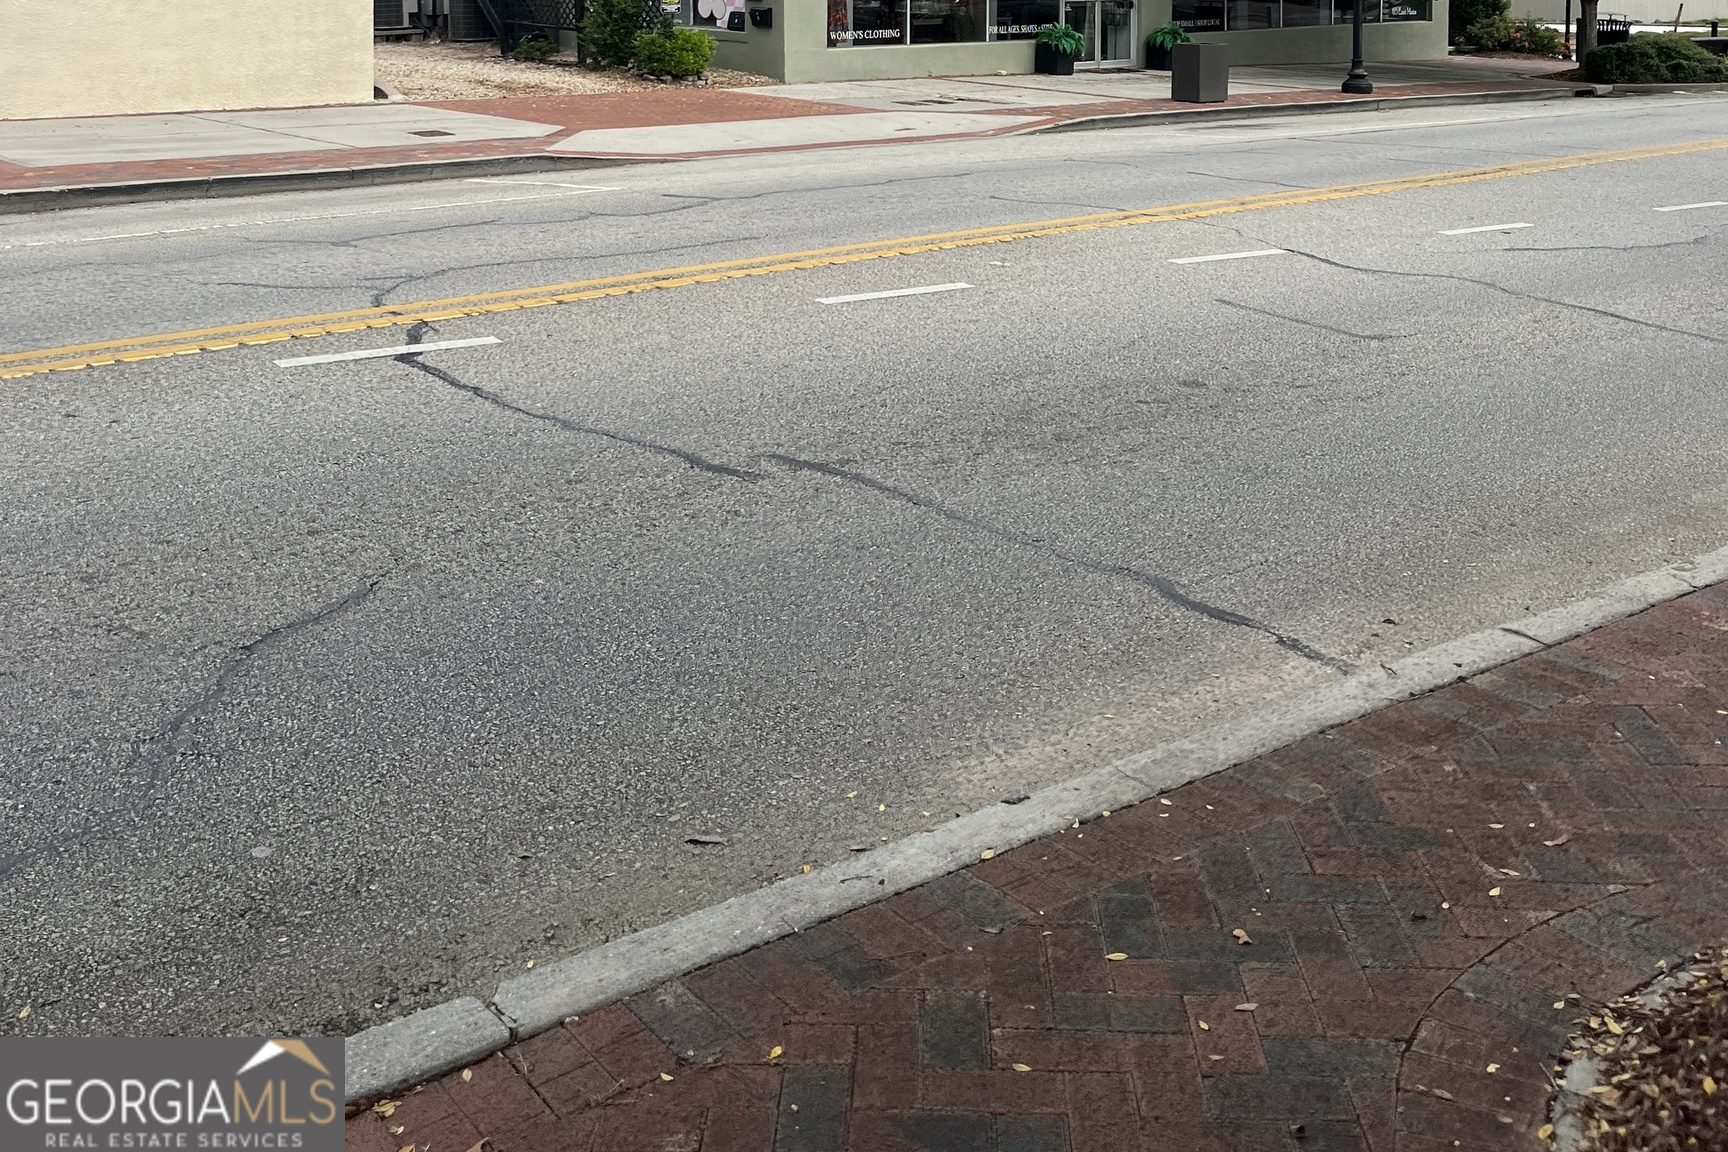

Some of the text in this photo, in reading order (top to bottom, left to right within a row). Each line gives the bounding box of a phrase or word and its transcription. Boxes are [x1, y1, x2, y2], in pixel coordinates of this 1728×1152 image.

[830, 28, 900, 40] WOMEN'S CLOTHING
[989, 25, 998, 34] FOR
[999, 25, 1007, 34] ALL
